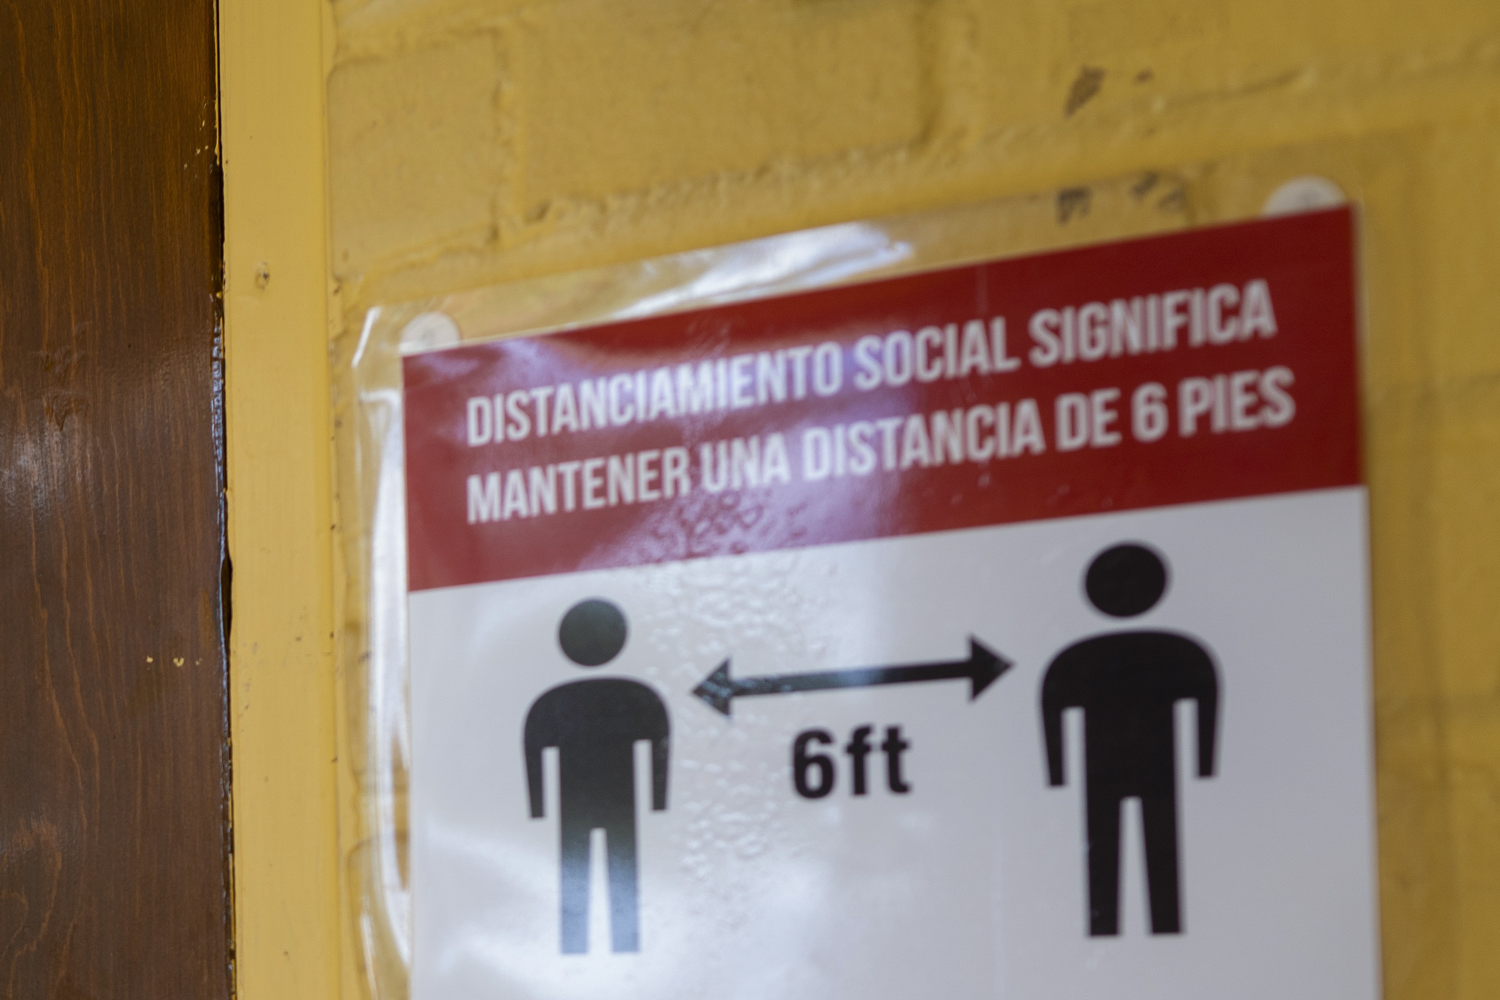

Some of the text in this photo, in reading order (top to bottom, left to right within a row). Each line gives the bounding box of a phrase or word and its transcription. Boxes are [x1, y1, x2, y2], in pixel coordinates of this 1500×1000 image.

[467, 278, 1278, 447] DISTANCIAMIENTO SOCIAL SIGNIFICA
[467, 366, 1296, 524] MANTENER UNA DISTANCIA DE 6 PIES
[791, 723, 911, 799] 6ft
